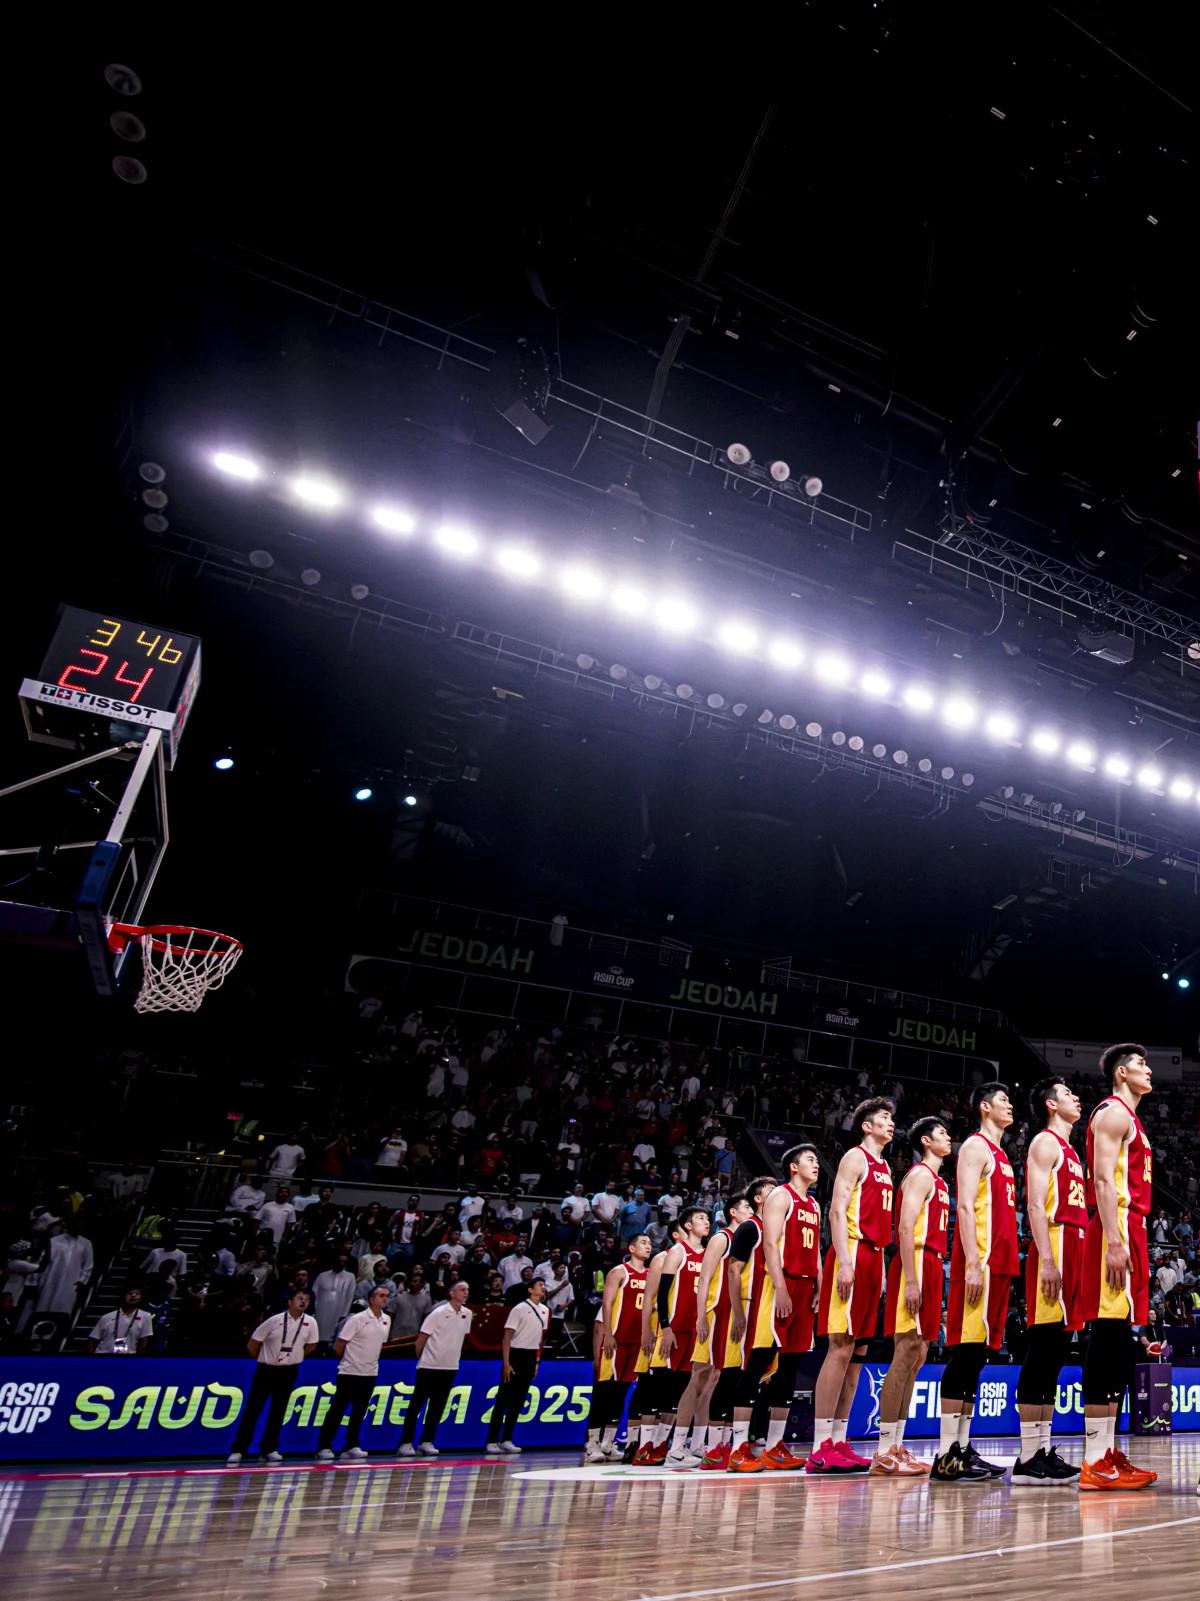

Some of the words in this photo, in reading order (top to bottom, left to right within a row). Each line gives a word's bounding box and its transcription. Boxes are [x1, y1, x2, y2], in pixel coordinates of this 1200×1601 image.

[90, 619, 121, 647] 3
[136, 631, 182, 664] 46
[57, 649, 154, 702] 24
[76, 692, 157, 719] TISSOT
[395, 928, 535, 974] JEDDAH
[669, 978, 778, 1016] JEDDAH
[889, 1017, 977, 1050] JEDDAH
[882, 1188, 892, 1212] 11
[1068, 1180, 1086, 1208] 26
[798, 1208, 818, 1226] CHINA
[802, 1227, 814, 1249] 10
[0, 1382, 60, 1406] ASIA
[980, 1382, 1007, 1398] ASIA
[69, 1382, 244, 1430] SAUD
[979, 1398, 1007, 1417] CUP
